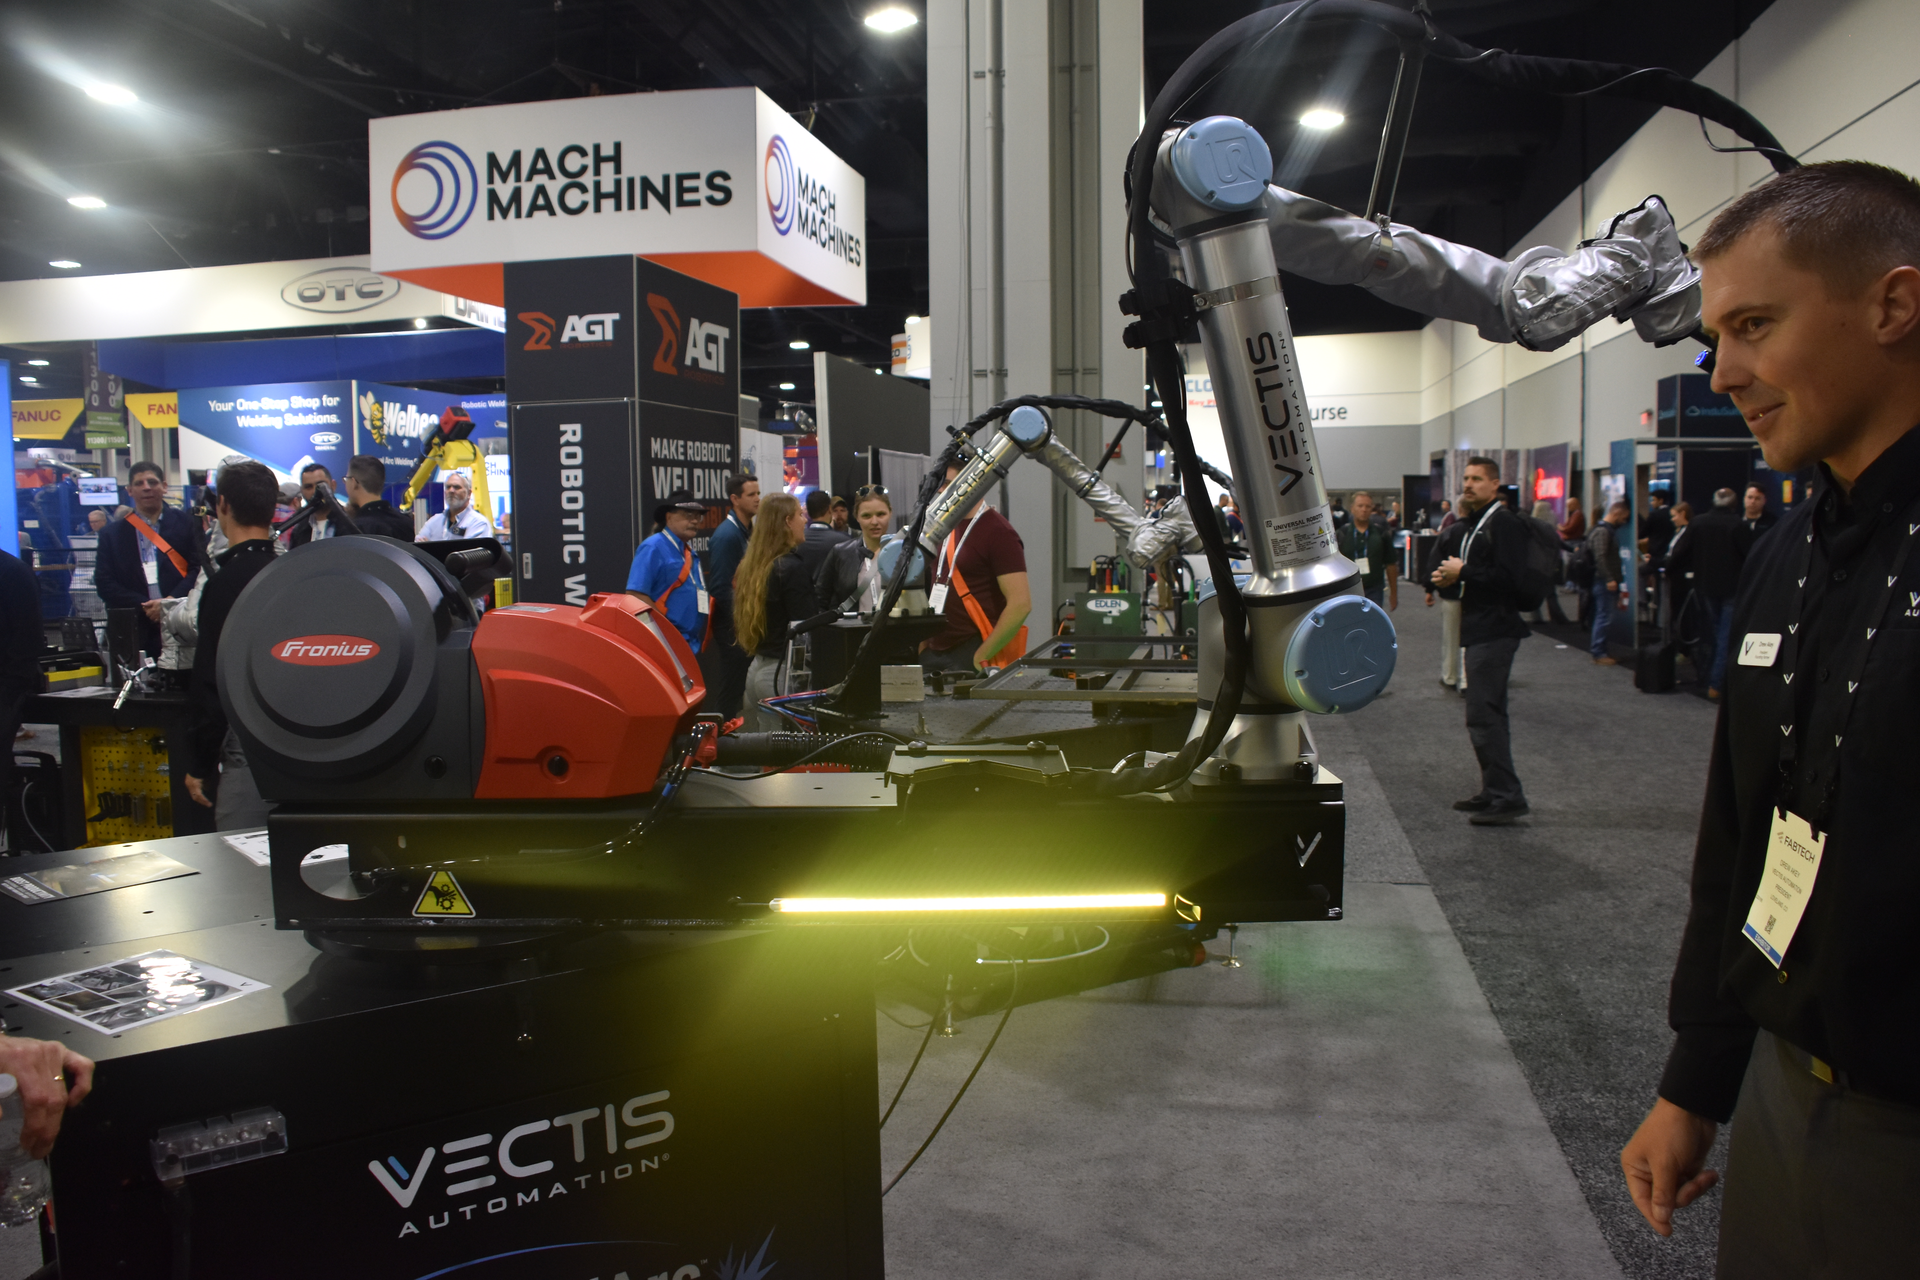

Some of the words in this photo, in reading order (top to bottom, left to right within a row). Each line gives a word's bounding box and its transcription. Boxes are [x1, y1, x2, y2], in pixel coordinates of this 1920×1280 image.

[486, 141, 622, 185] MACH
[486, 170, 733, 221] MACHINES
[798, 166, 836, 223] MACH
[798, 200, 861, 267] MACHINES
[297, 277, 384, 303] OTC
[560, 312, 620, 343] AGT
[560, 341, 613, 350] ROBOTICS
[684, 317, 730, 374] AGT
[684, 370, 725, 386] ROBOTICS
[208, 400, 235, 412] Your
[236, 397, 289, 412] One-Stop
[290, 395, 320, 410] Shop
[322, 394, 340, 407] for
[461, 400, 487, 409] Robotic
[1246, 331, 1303, 496] VECTIS
[236, 413, 283, 429] Welding
[283, 412, 340, 426] Solutions.
[650, 437, 685, 460] MAKE
[686, 440, 732, 463] ROBOTIC
[559, 423, 585, 565] ROBOTIC
[1273, 519, 1306, 531] UNIVERSAL
[1305, 512, 1324, 523] ROBOTS
[1094, 600, 1122, 608] EDLEN
[281, 641, 373, 657] Fronius
[1783, 835, 1816, 864] FABTECH
[368, 1090, 675, 1208] VECTIS
